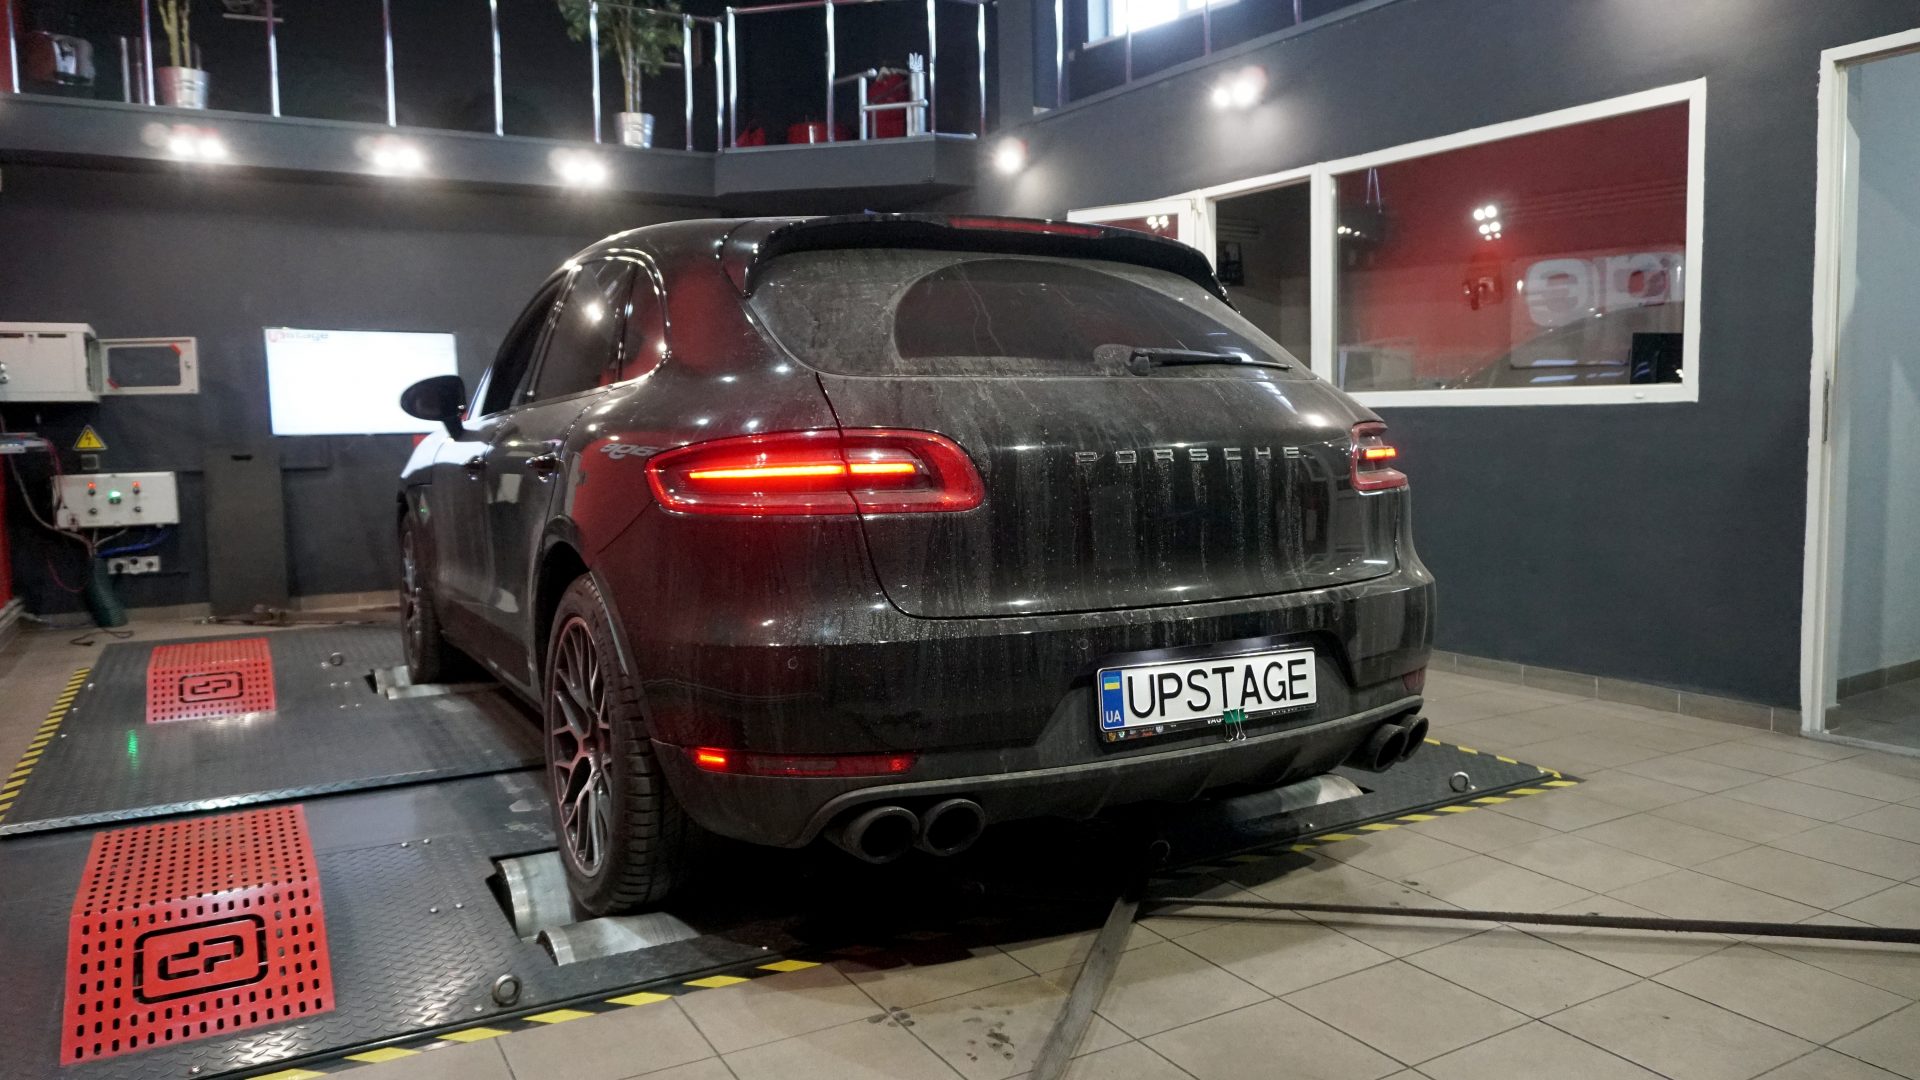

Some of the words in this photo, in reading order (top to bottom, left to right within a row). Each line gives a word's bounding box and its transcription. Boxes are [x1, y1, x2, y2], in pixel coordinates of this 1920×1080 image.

[1075, 446, 1300, 463] PORSCHE
[1128, 658, 1309, 719] UPSTAGE
[1105, 709, 1122, 723] UA
